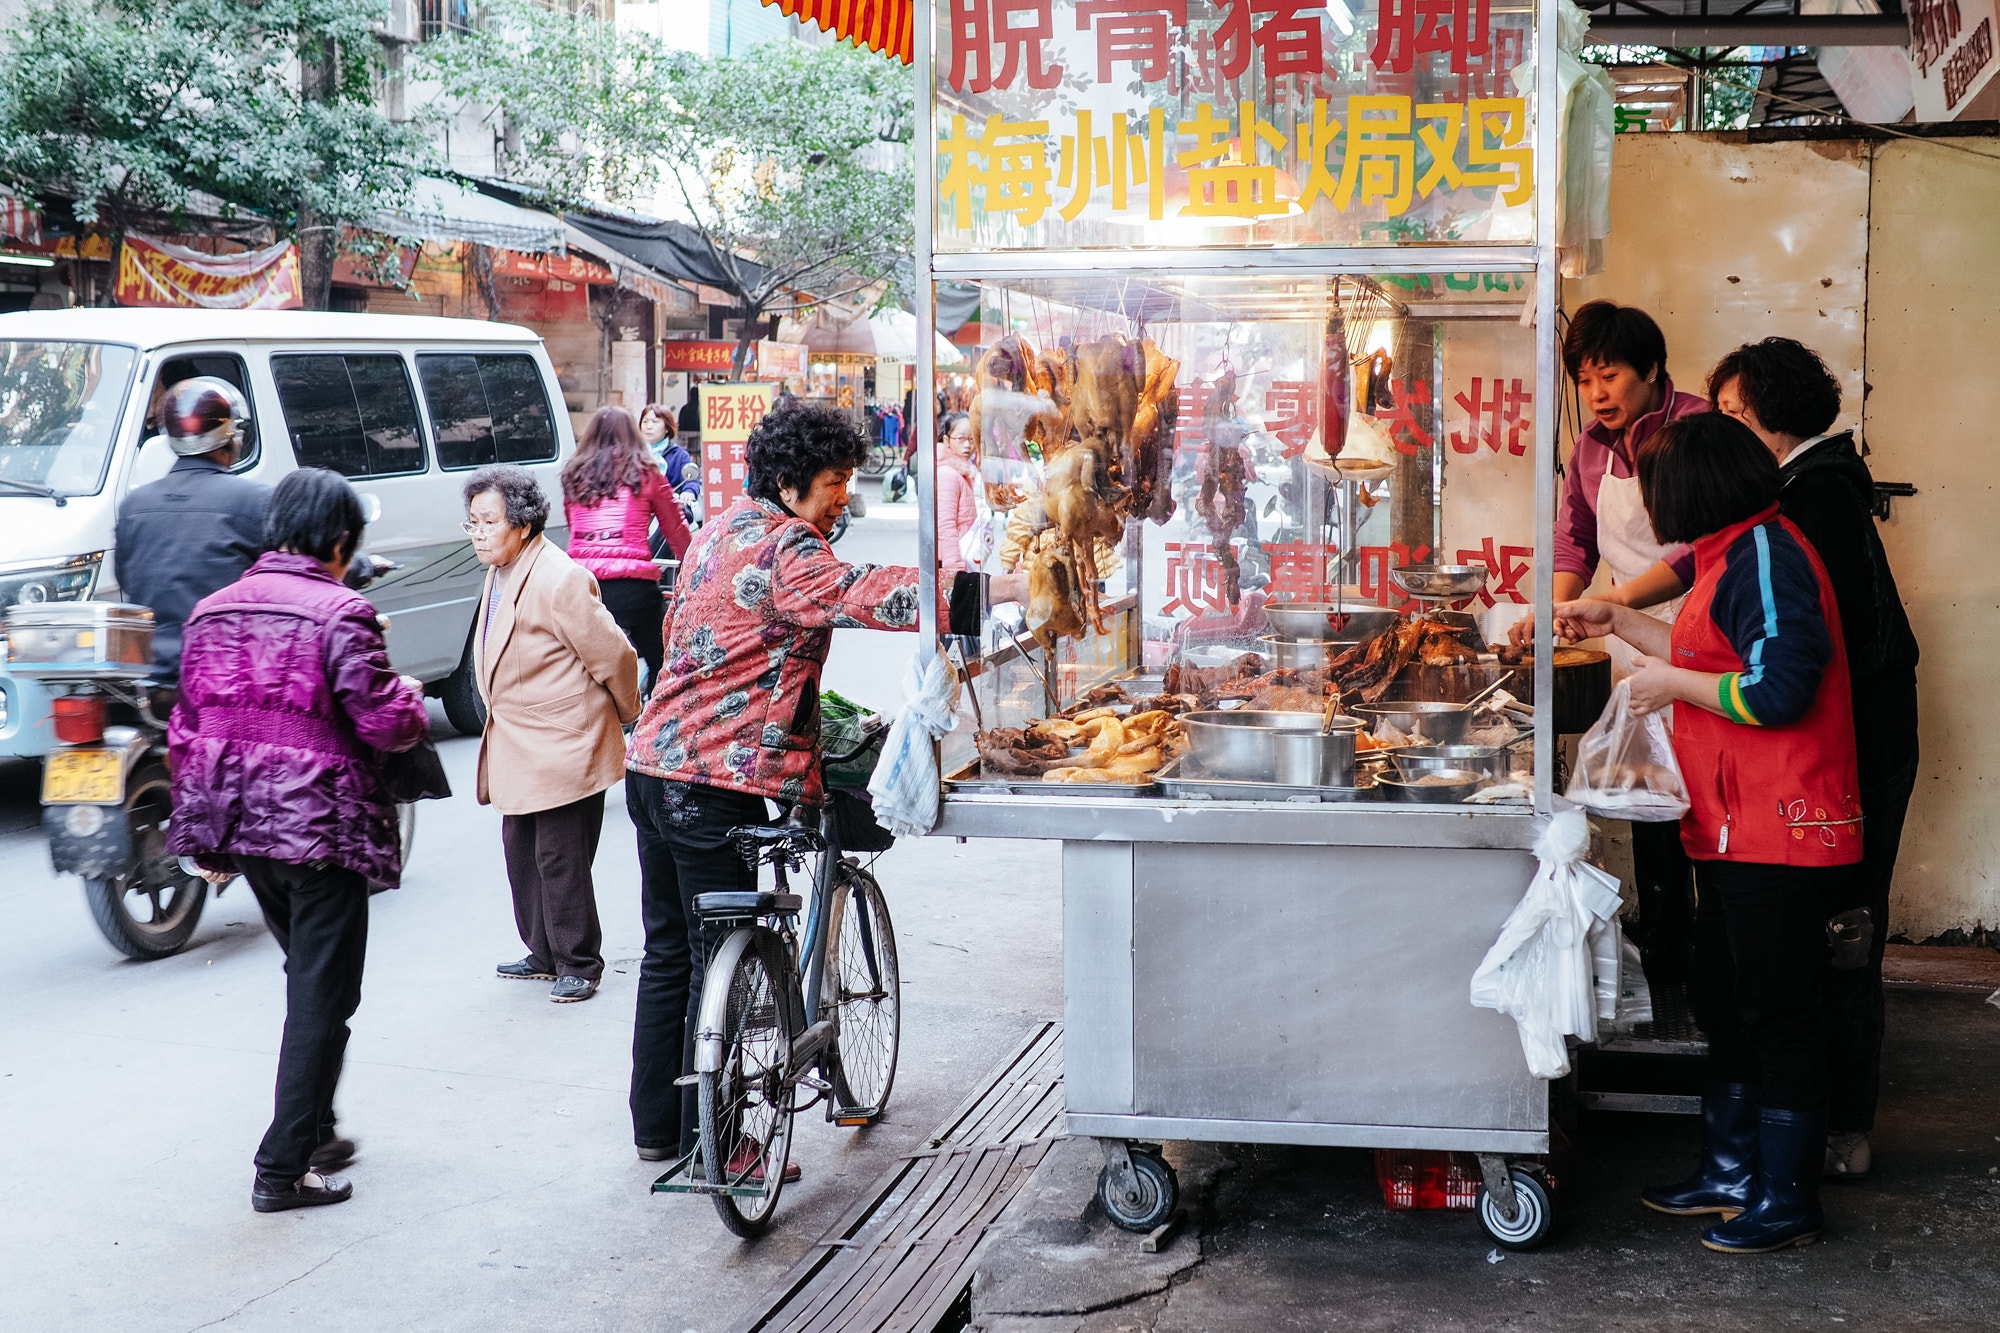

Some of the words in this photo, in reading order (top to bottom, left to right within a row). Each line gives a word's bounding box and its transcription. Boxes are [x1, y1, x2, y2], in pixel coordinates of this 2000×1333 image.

[938, 95, 1534, 229] 梅州盐焗鸡
[707, 394, 766, 430] 肠粉
